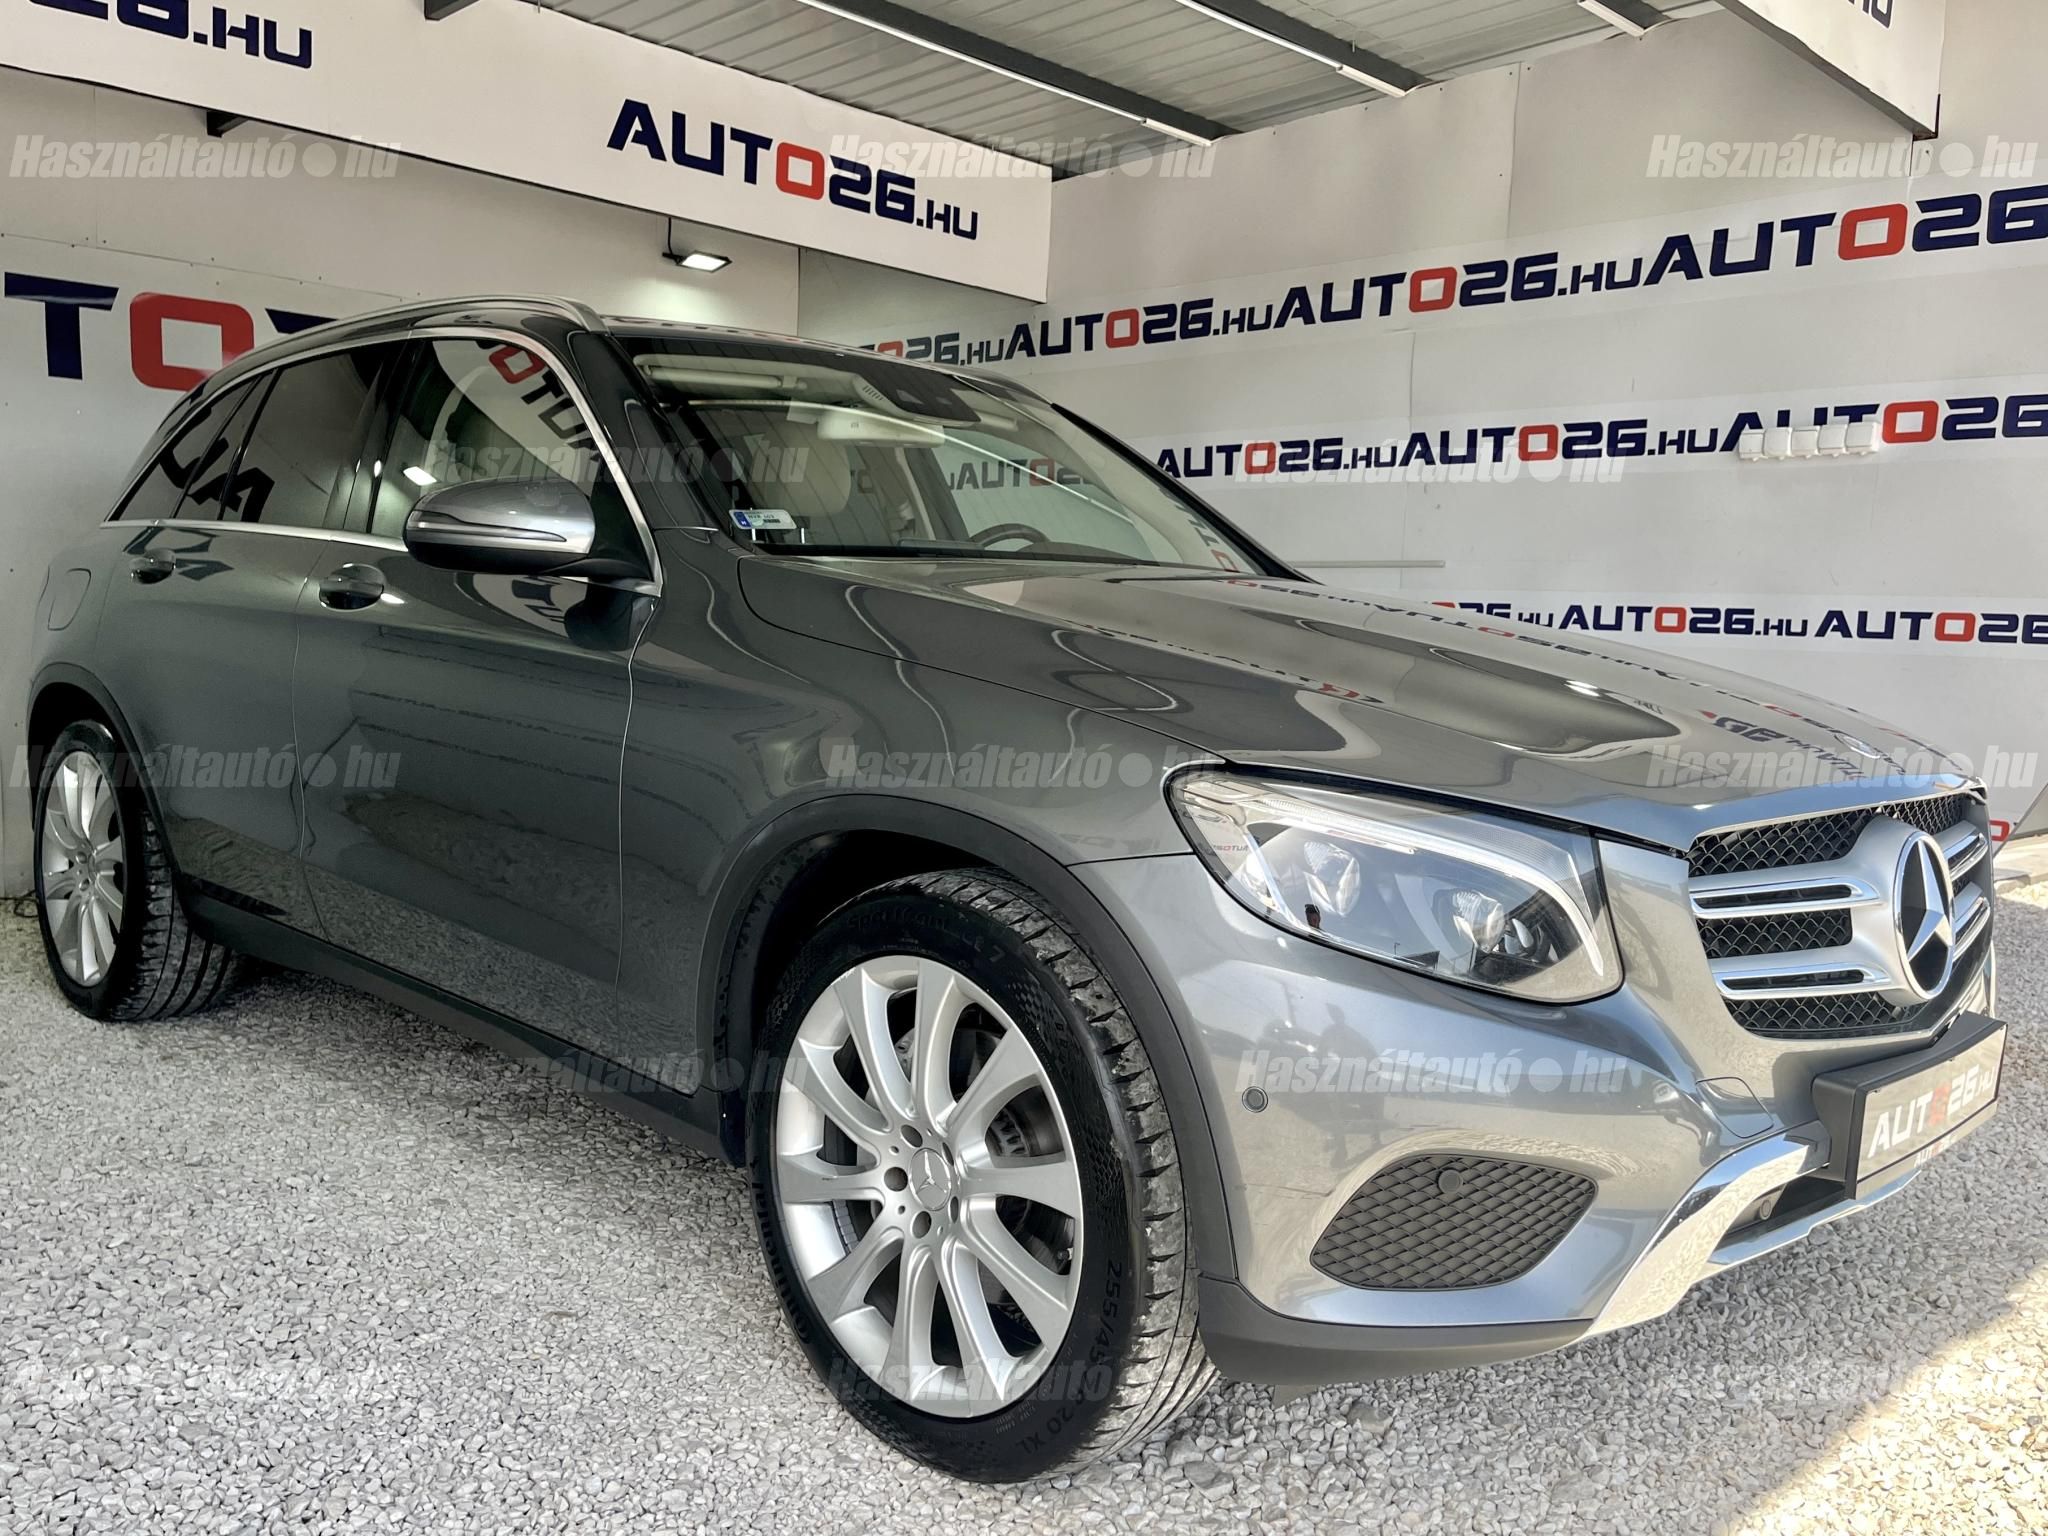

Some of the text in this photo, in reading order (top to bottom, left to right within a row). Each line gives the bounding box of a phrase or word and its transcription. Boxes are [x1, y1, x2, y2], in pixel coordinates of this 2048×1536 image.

[606, 98, 979, 241] AUTO26.HU
[1004, 298, 1273, 360] AUTO26.HU
[1273, 251, 1643, 329] AUTO26.HU
[1643, 184, 2048, 286] AUTO26
[1156, 437, 1397, 478] AUTO26.HU
[1399, 419, 1718, 467] AUTO26.HU
[1558, 604, 1808, 637] AUTO26.HU
